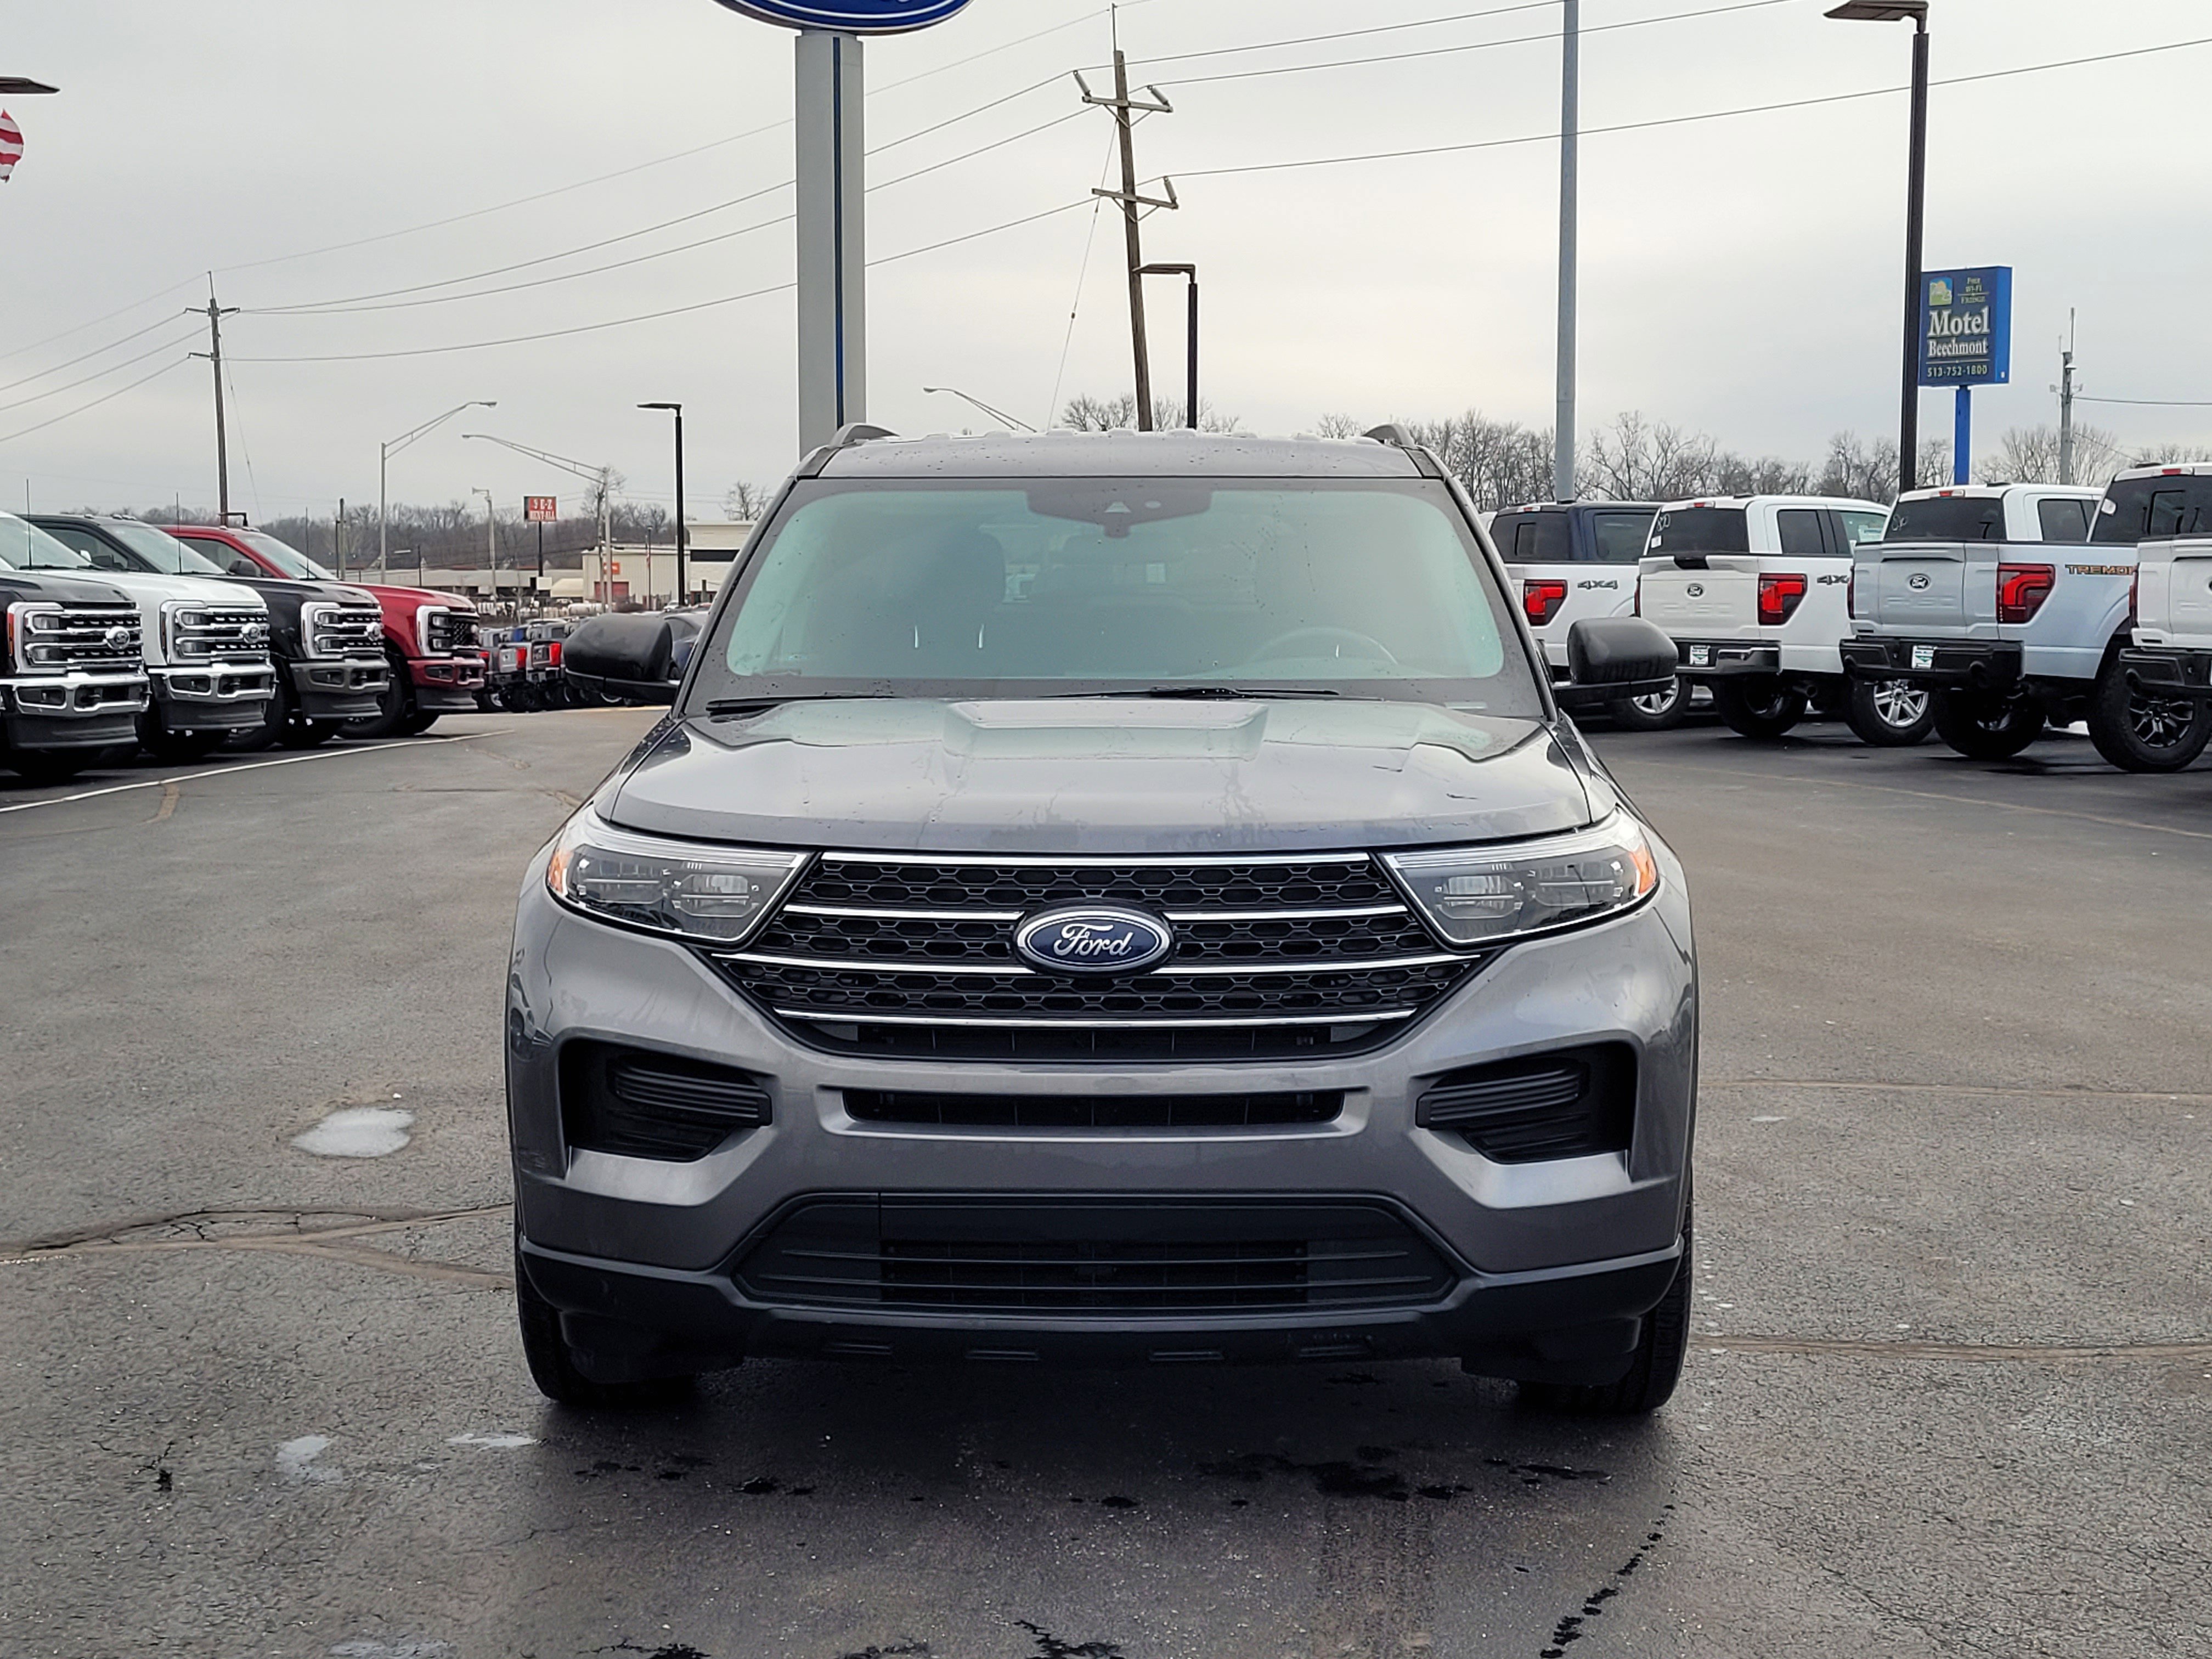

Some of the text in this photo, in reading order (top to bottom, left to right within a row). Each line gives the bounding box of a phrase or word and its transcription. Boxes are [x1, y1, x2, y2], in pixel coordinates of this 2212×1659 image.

[1927, 306, 1990, 337] Motel
[1927, 338, 1988, 358] Beechmont
[1927, 365, 1988, 377] 513-752-1800
[1053, 923, 1133, 956] Ford
